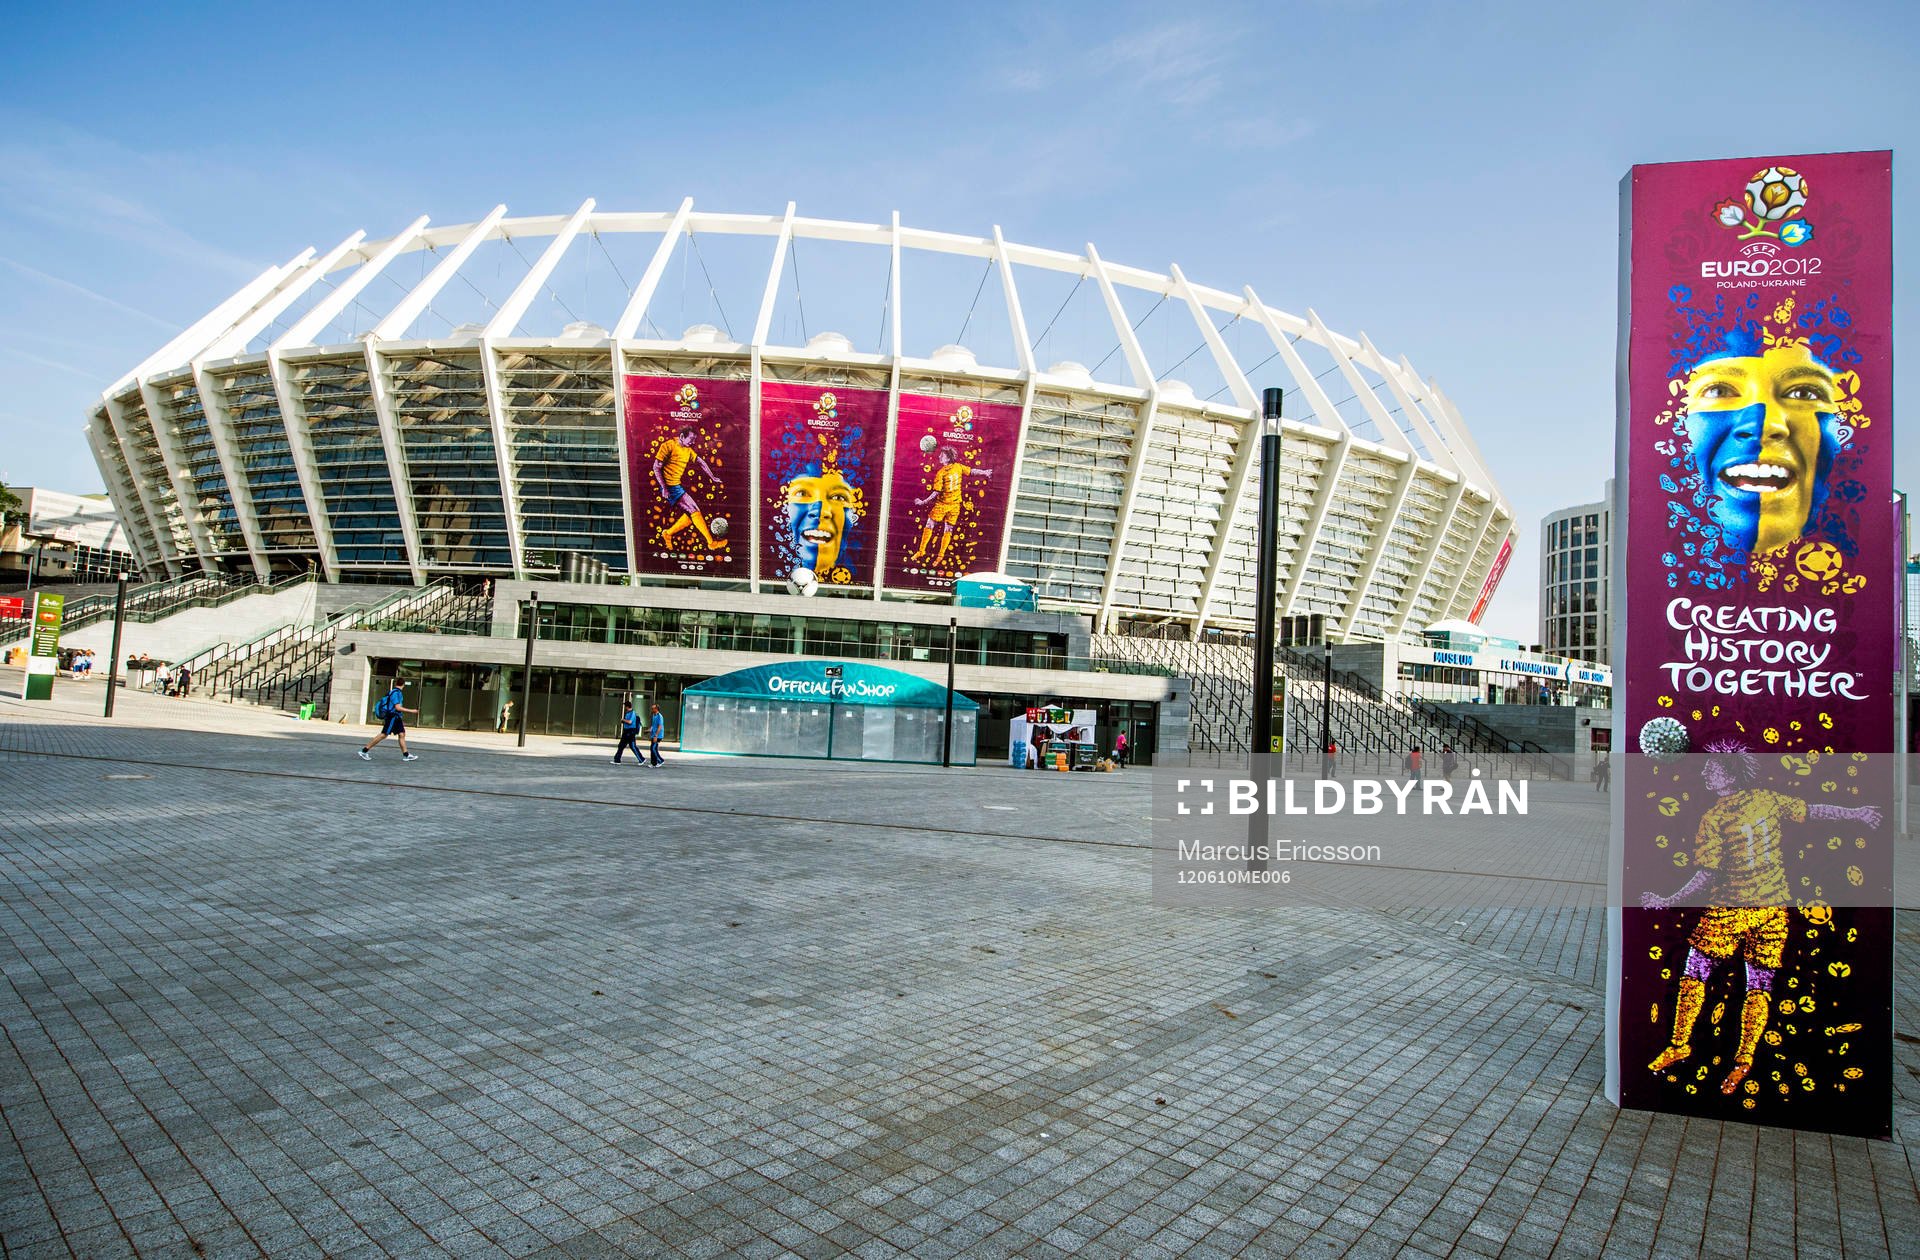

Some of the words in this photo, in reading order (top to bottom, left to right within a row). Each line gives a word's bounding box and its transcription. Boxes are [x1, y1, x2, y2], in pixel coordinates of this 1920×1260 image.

[1743, 244, 1777, 257] UEFA
[1716, 279, 1807, 289] POLAND-UKRAINE
[1666, 597, 1837, 635] CREATING
[1684, 628, 1831, 671] HISTORY
[1433, 651, 1473, 666] MUSEUM
[1512, 661, 1542, 674] DYNAMO
[768, 676, 831, 695] OFFICIAL
[1741, 817, 1772, 868] 11
